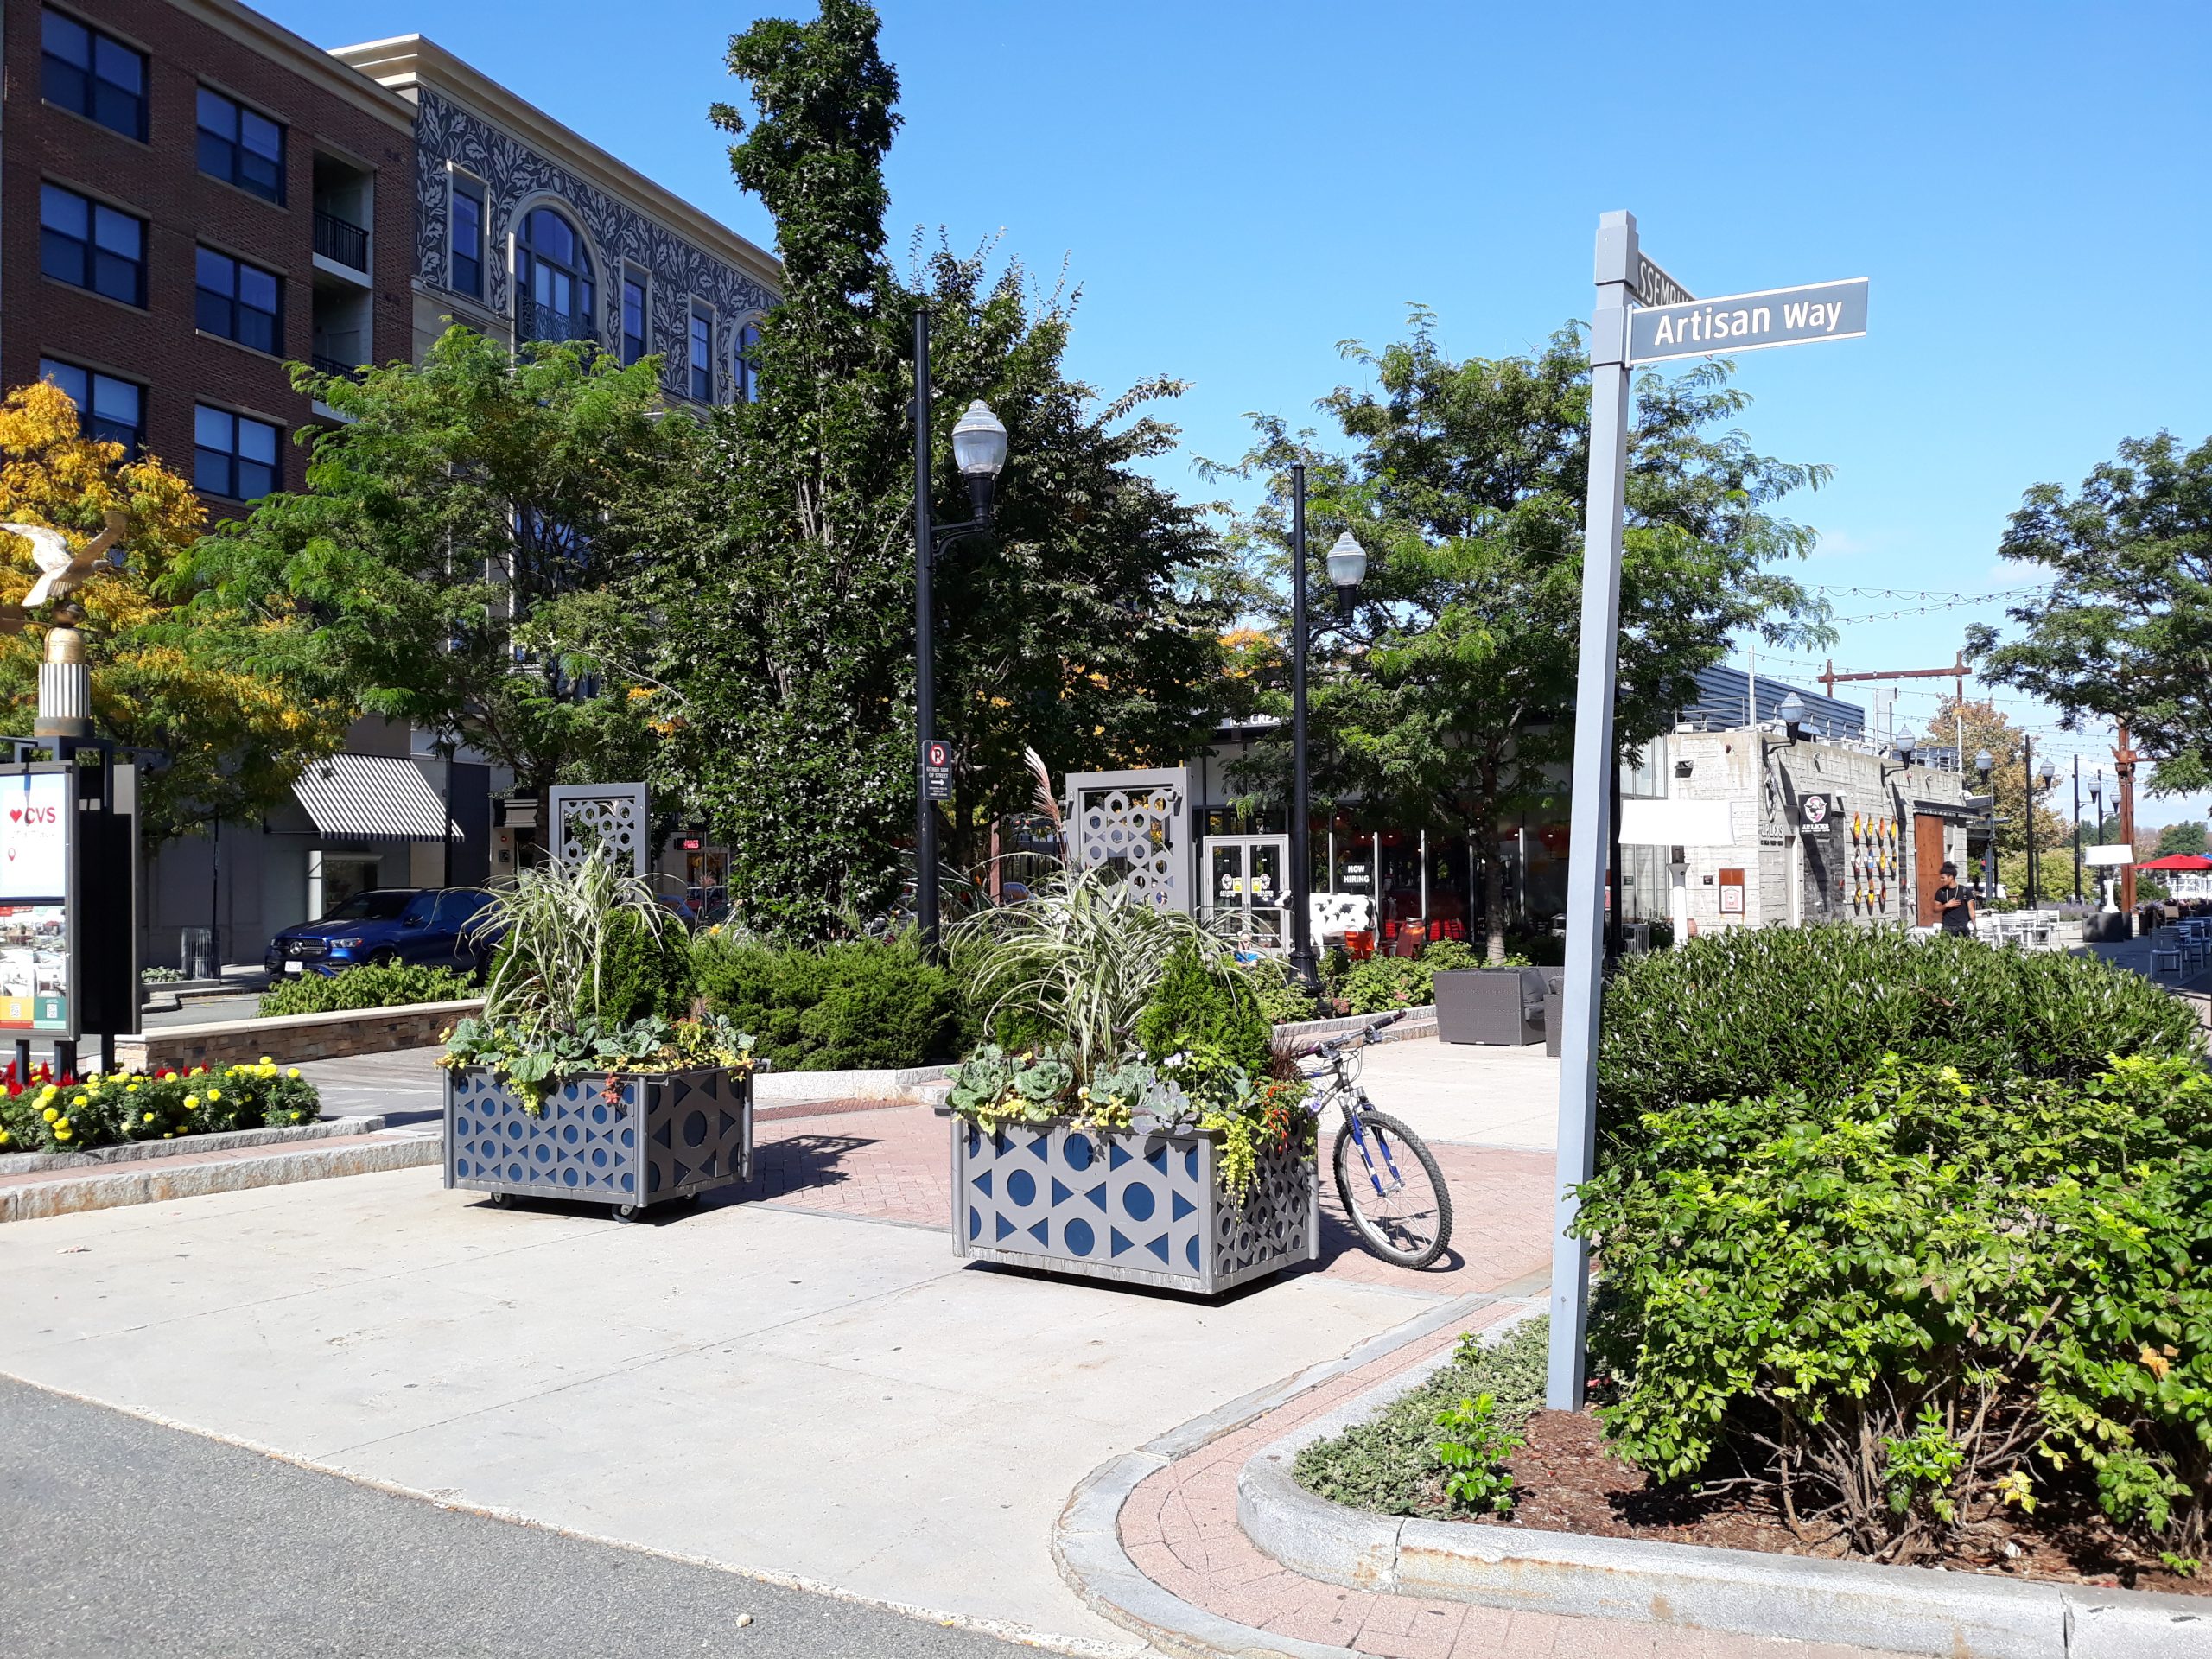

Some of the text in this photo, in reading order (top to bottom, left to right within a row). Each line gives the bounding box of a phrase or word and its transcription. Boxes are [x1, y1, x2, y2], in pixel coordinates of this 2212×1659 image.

[1654, 301, 1842, 346] Artisan Way
[24, 807, 56, 824] CVS
